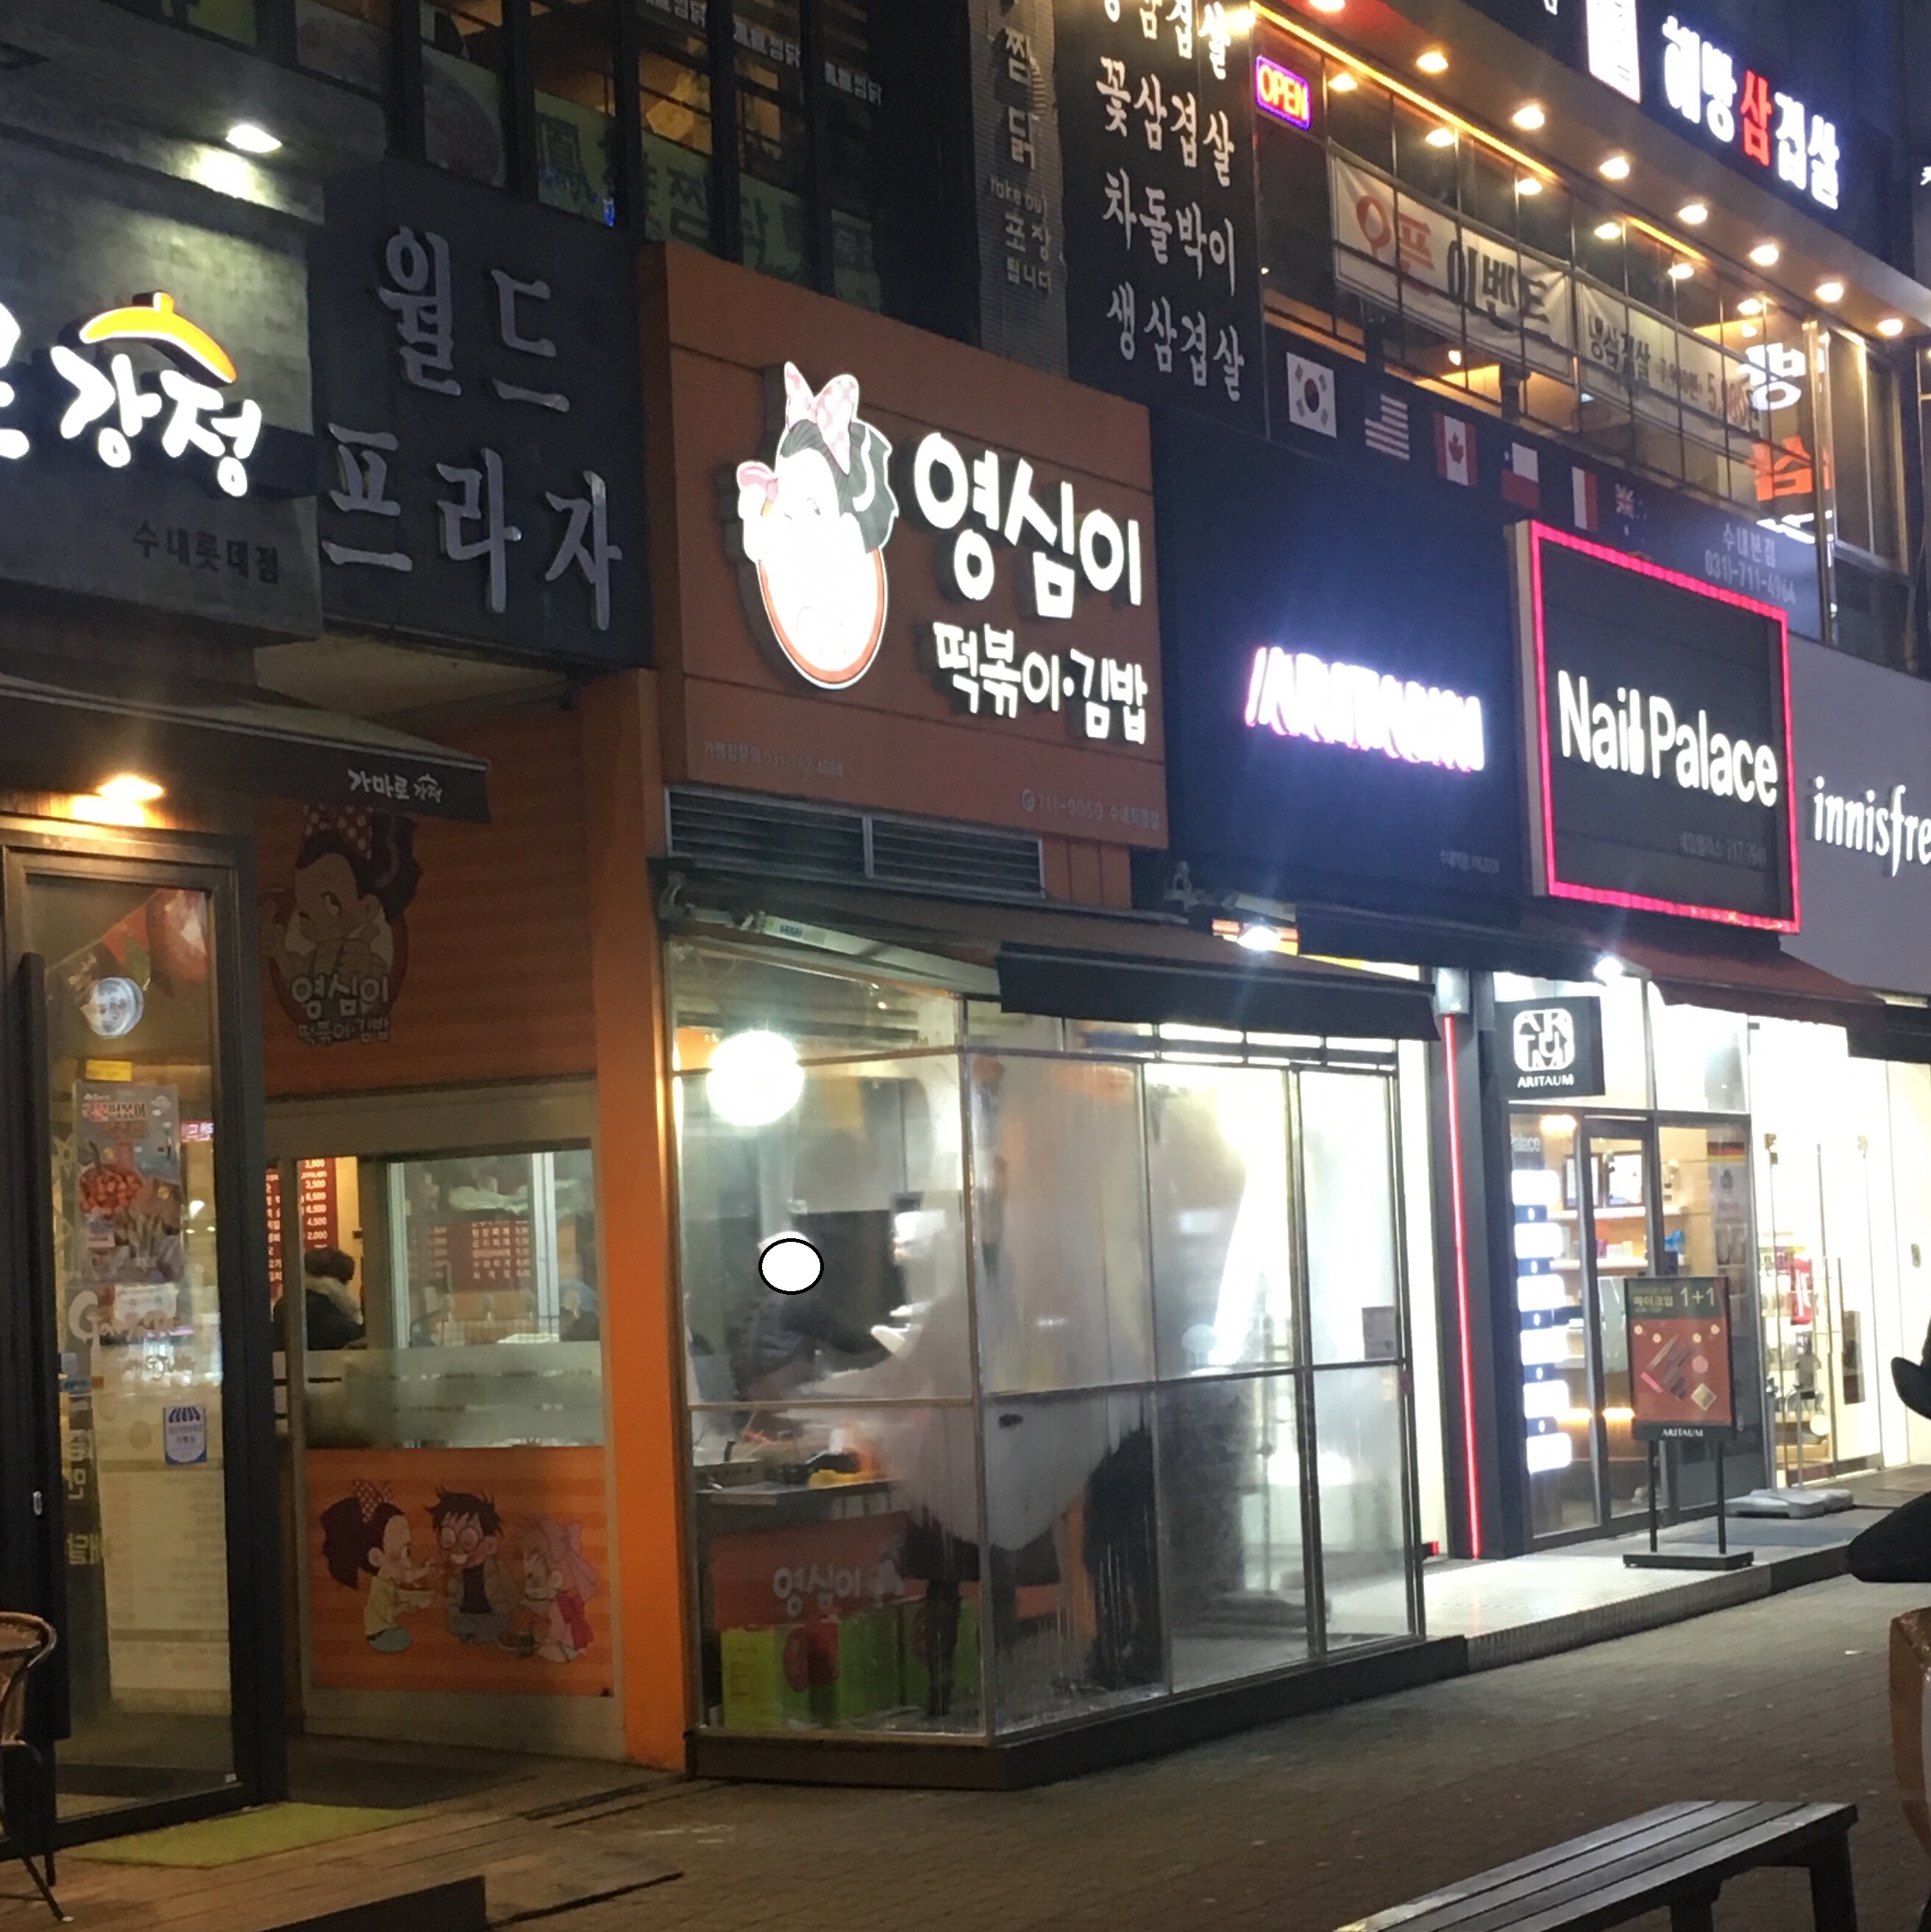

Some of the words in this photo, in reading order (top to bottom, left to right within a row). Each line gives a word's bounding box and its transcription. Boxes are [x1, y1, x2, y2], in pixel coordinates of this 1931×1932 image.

[1104, 0, 1231, 79] 삼겹살
[1096, 57, 1234, 187] 꽃삼겹살
[1259, 64, 1309, 120] OPEN
[1103, 168, 1235, 296] 차돌박이
[377, 225, 571, 413] 월드
[1106, 282, 1245, 402] 생삼겹살
[321, 422, 622, 631] 프라자
[914, 433, 1142, 619] 영심이
[347, 769, 410, 800] 가마로
[1557, 670, 1644, 776] Nail
[1649, 695, 1778, 807] Palace
[292, 973, 389, 1020] 영심이
[1518, 1073, 1574, 1088] ARITAUM
[1679, 1287, 1715, 1307] 1+1
[773, 1564, 860, 1617] 영심이
